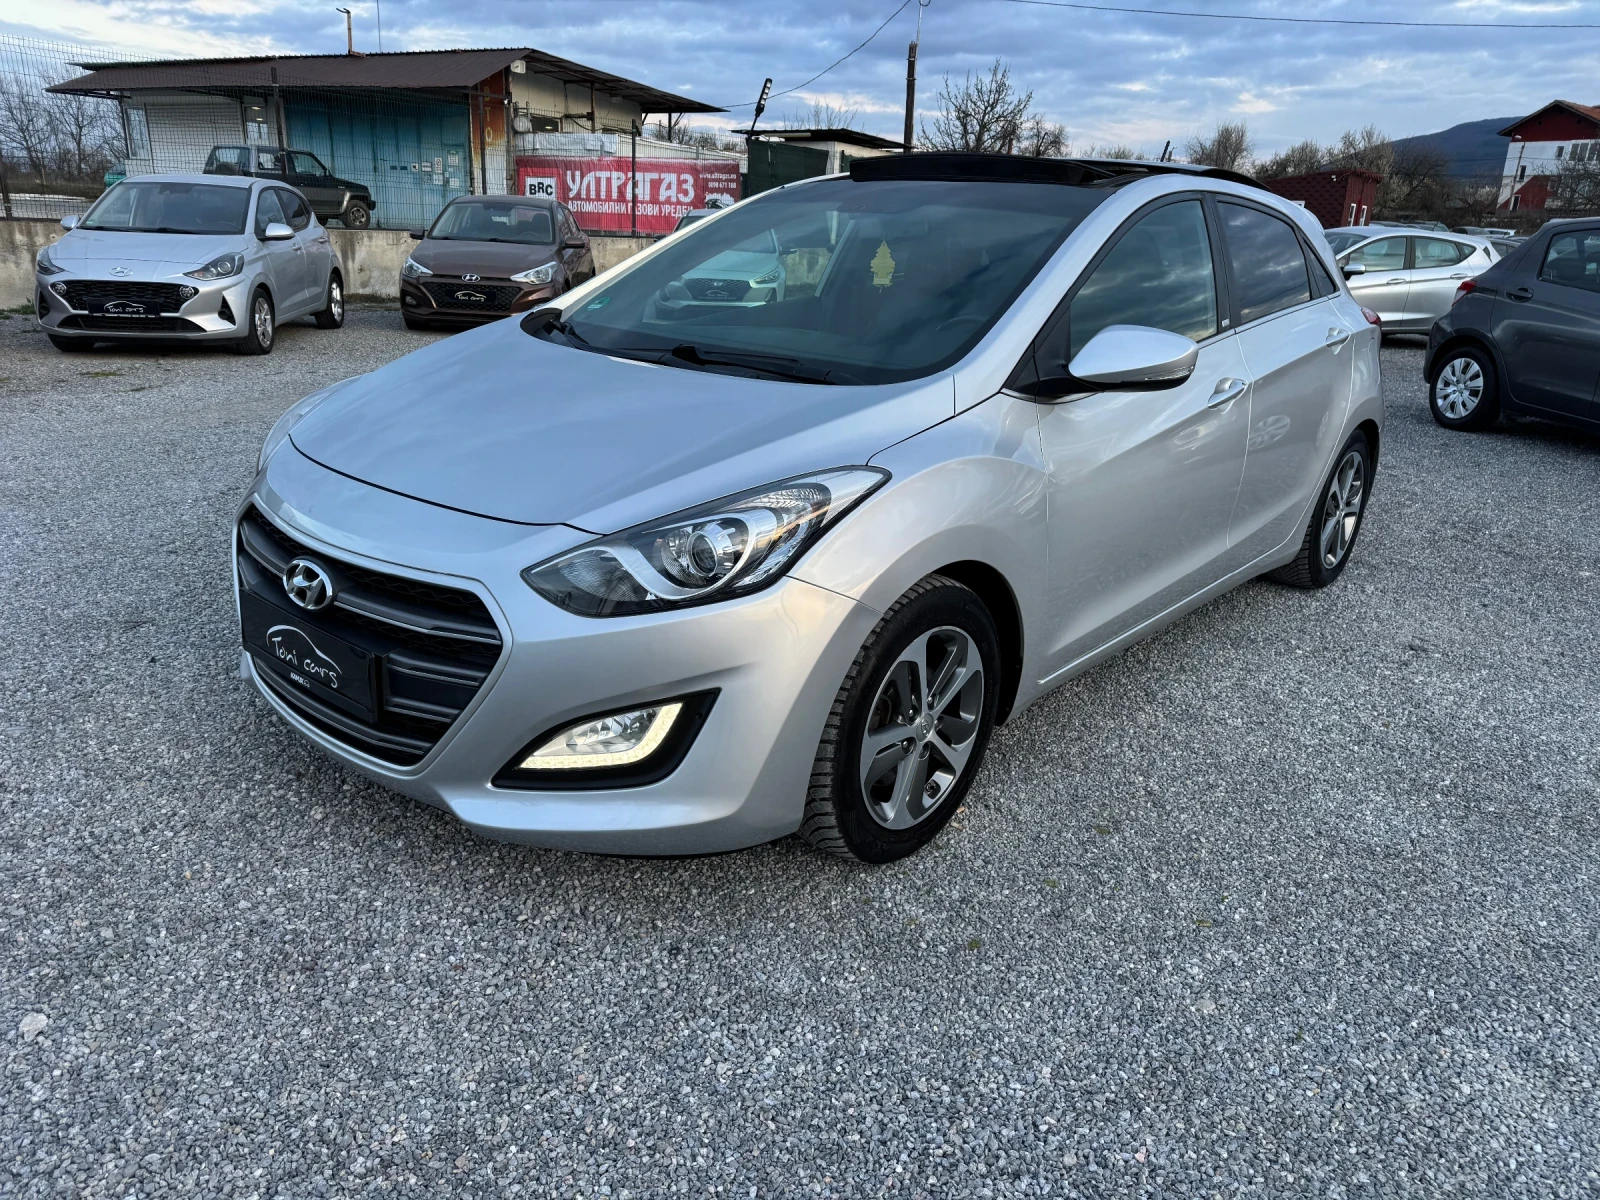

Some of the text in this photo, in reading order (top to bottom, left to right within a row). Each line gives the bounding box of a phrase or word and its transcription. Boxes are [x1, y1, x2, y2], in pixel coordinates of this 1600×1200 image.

[529, 182, 553, 196] BRC
[566, 170, 695, 203] УЛТРАГАЗ
[567, 200, 627, 215] АВТОМОБИЛНИ
[271, 636, 338, 689] Toni cars
